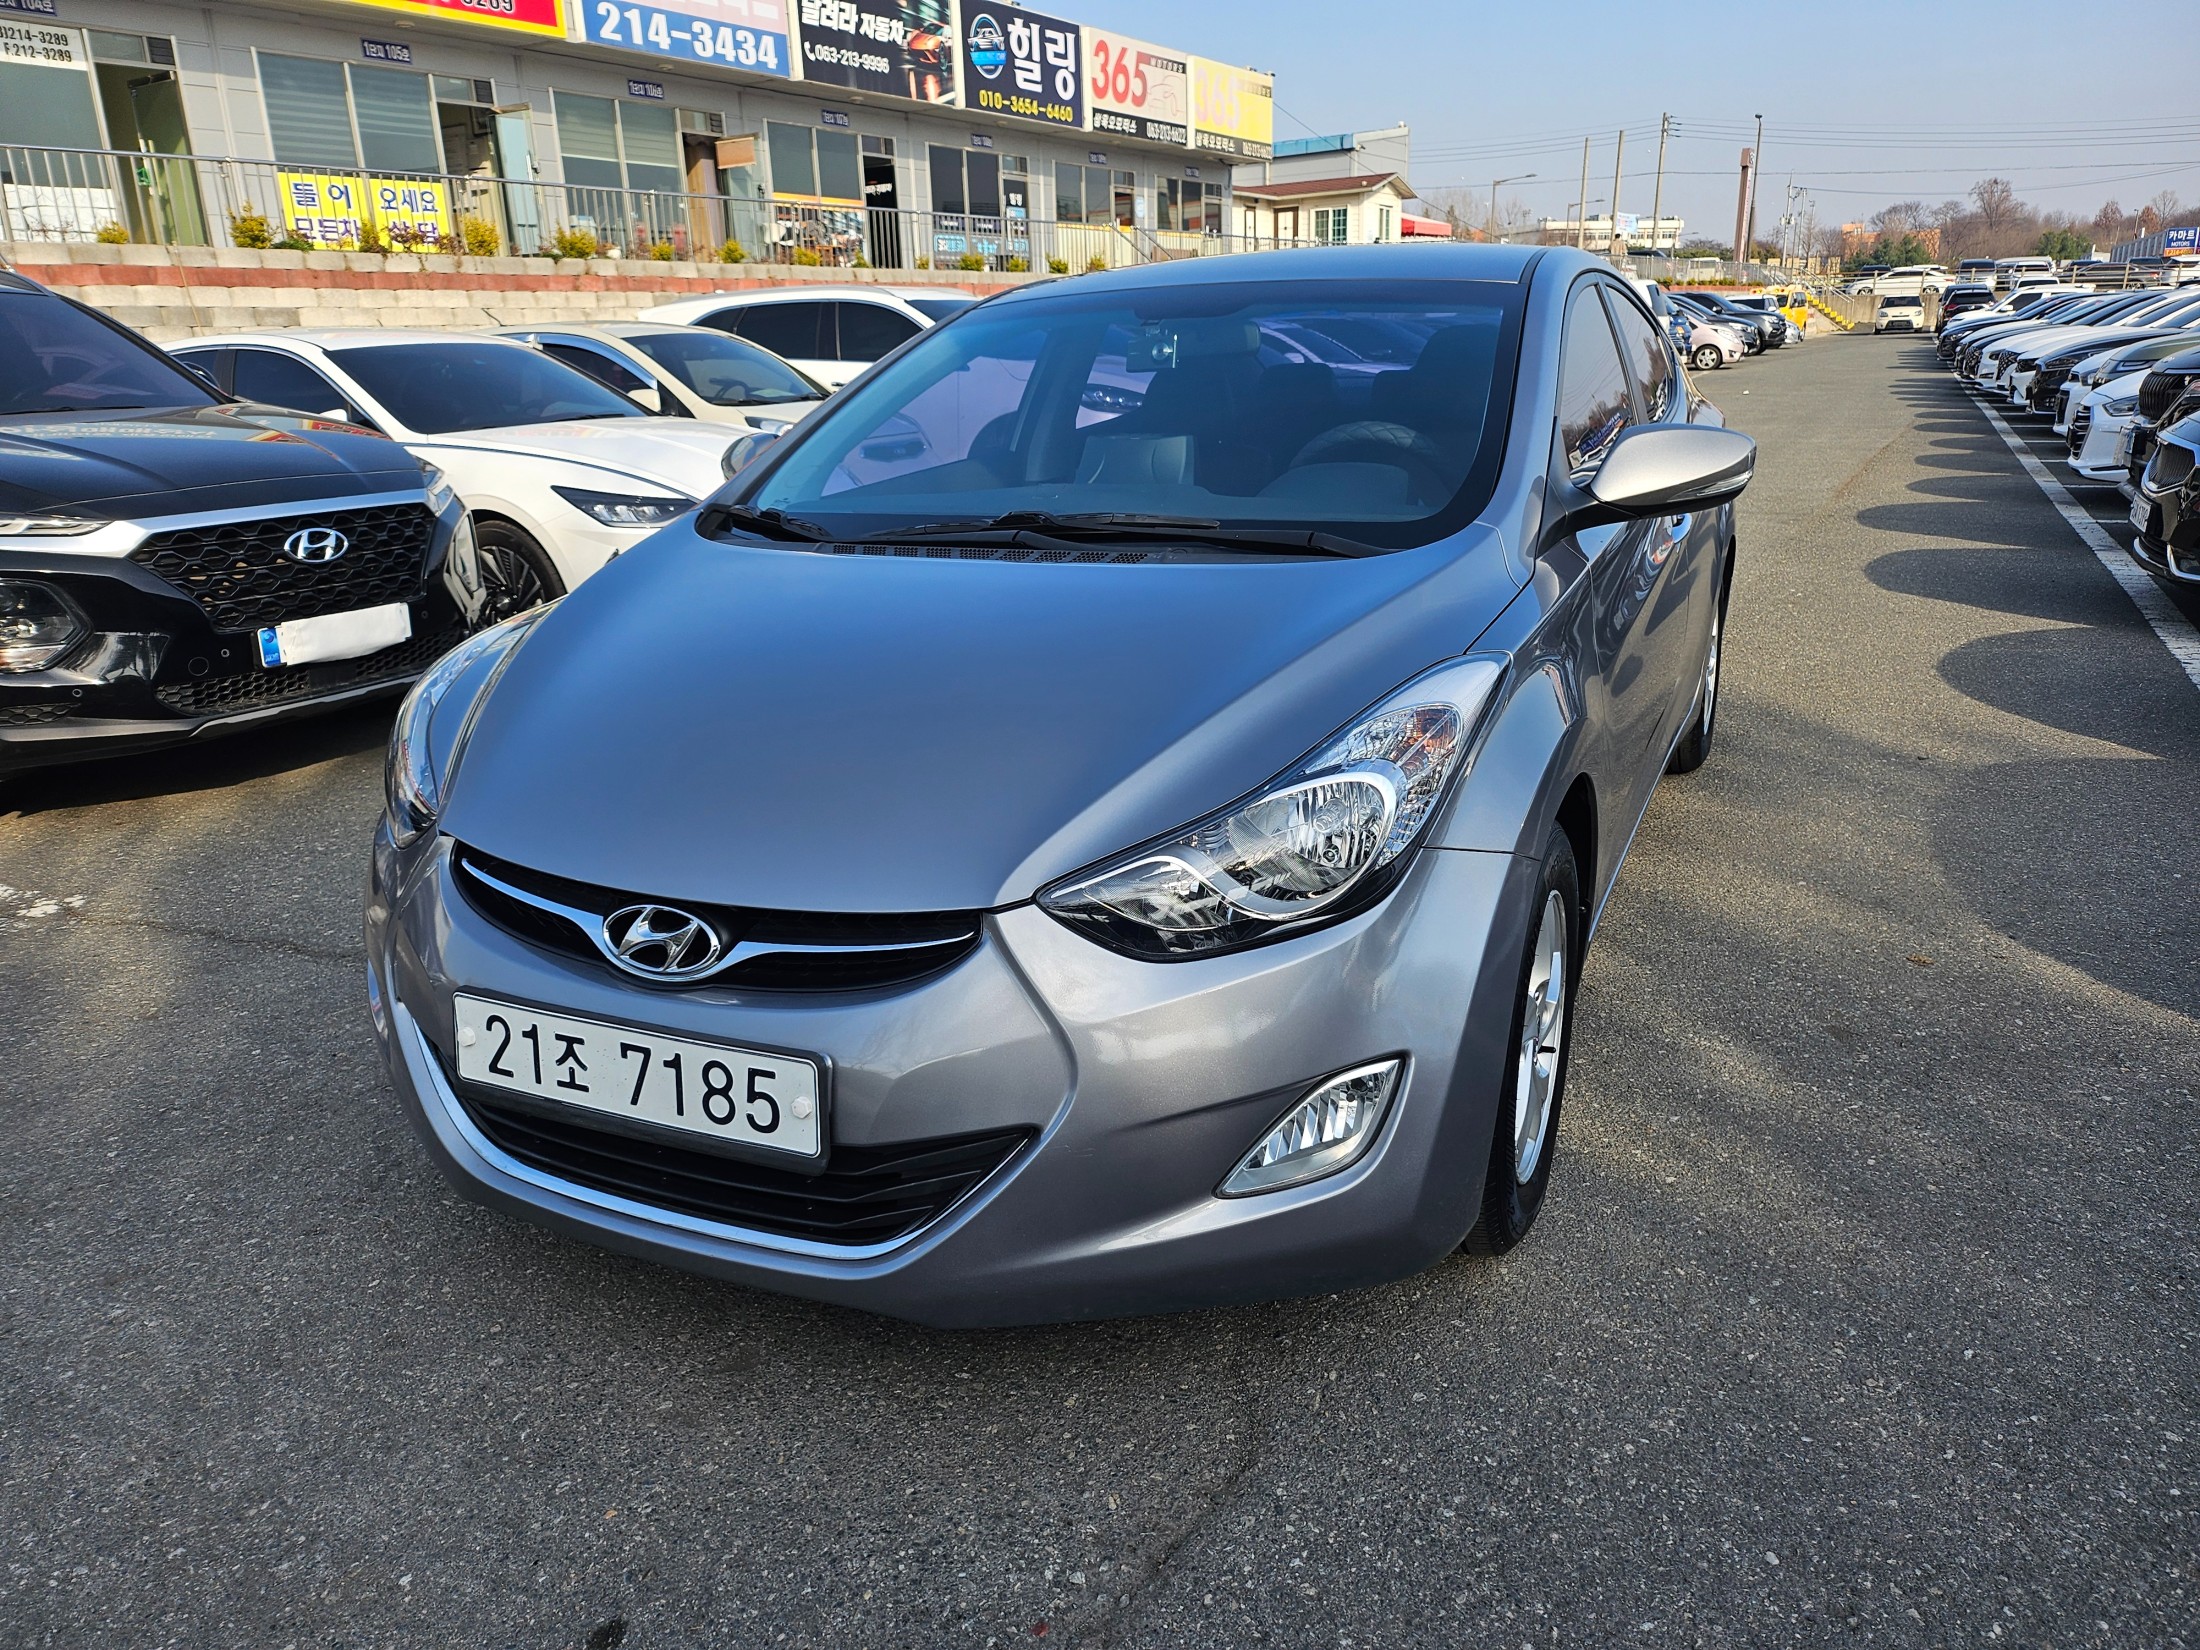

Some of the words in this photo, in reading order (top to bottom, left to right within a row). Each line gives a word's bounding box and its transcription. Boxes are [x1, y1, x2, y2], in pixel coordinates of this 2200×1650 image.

[596, 2, 778, 69] 214-3434
[801, 0, 859, 35] 달려라
[859, 12, 905, 46] 자동차
[385, 44, 411, 62] 105호
[1006, 17, 1076, 100] 힐링
[1091, 39, 1147, 108] 365
[979, 89, 1073, 122] 010-3654-6460
[379, 187, 439, 213] 오세요
[2169, 230, 2195, 240] 카마트
[485, 1013, 590, 1093] 21조
[619, 1041, 781, 1134] 7185
